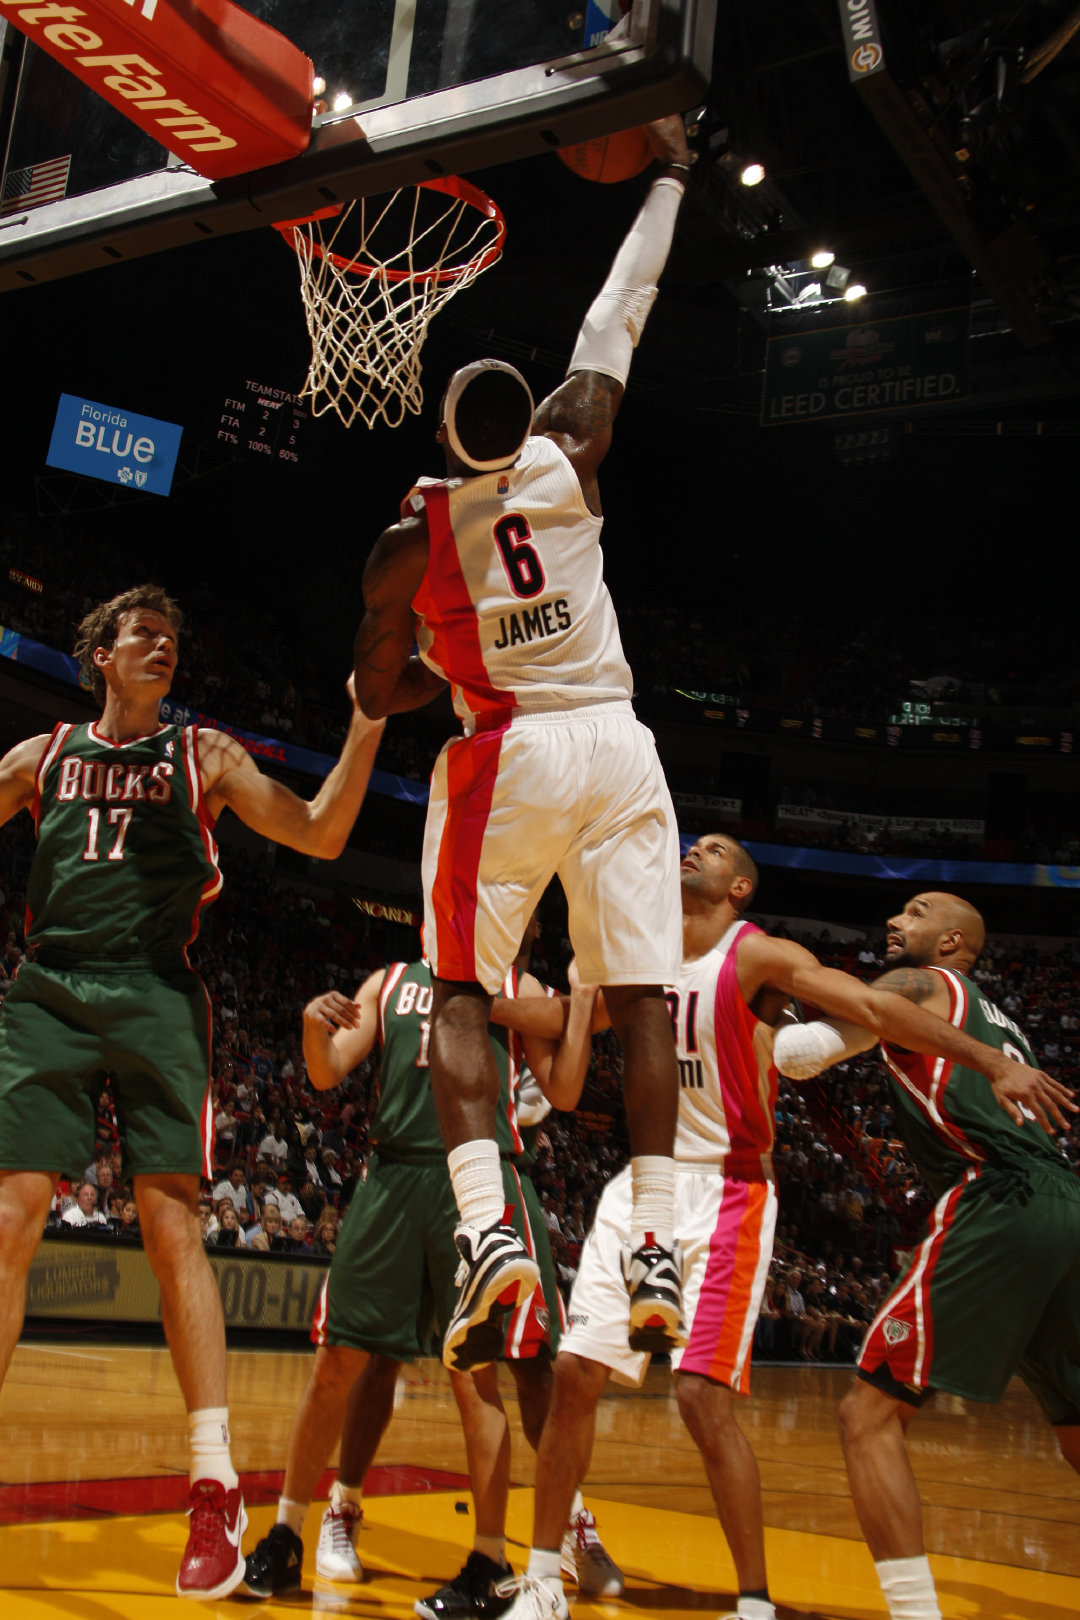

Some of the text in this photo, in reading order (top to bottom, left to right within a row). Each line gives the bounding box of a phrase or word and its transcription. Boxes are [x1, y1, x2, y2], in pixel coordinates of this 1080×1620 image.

[0, 0, 238, 152] te Farm
[770, 373, 960, 418] LEED CERTIFIED.
[818, 365, 912, 388] IS PROUD TO BE
[81, 404, 128, 428] Florida
[220, 414, 240, 428] FTA
[258, 426, 266, 436] 2
[224, 398, 300, 429] FTM 2 3
[217, 429, 299, 463] FT% 100% 60%
[494, 513, 546, 599] 6
[495, 599, 572, 649] JAMES
[173, 707, 191, 726] at
[56, 755, 174, 804] BUCKS
[83, 807, 133, 861] 17
